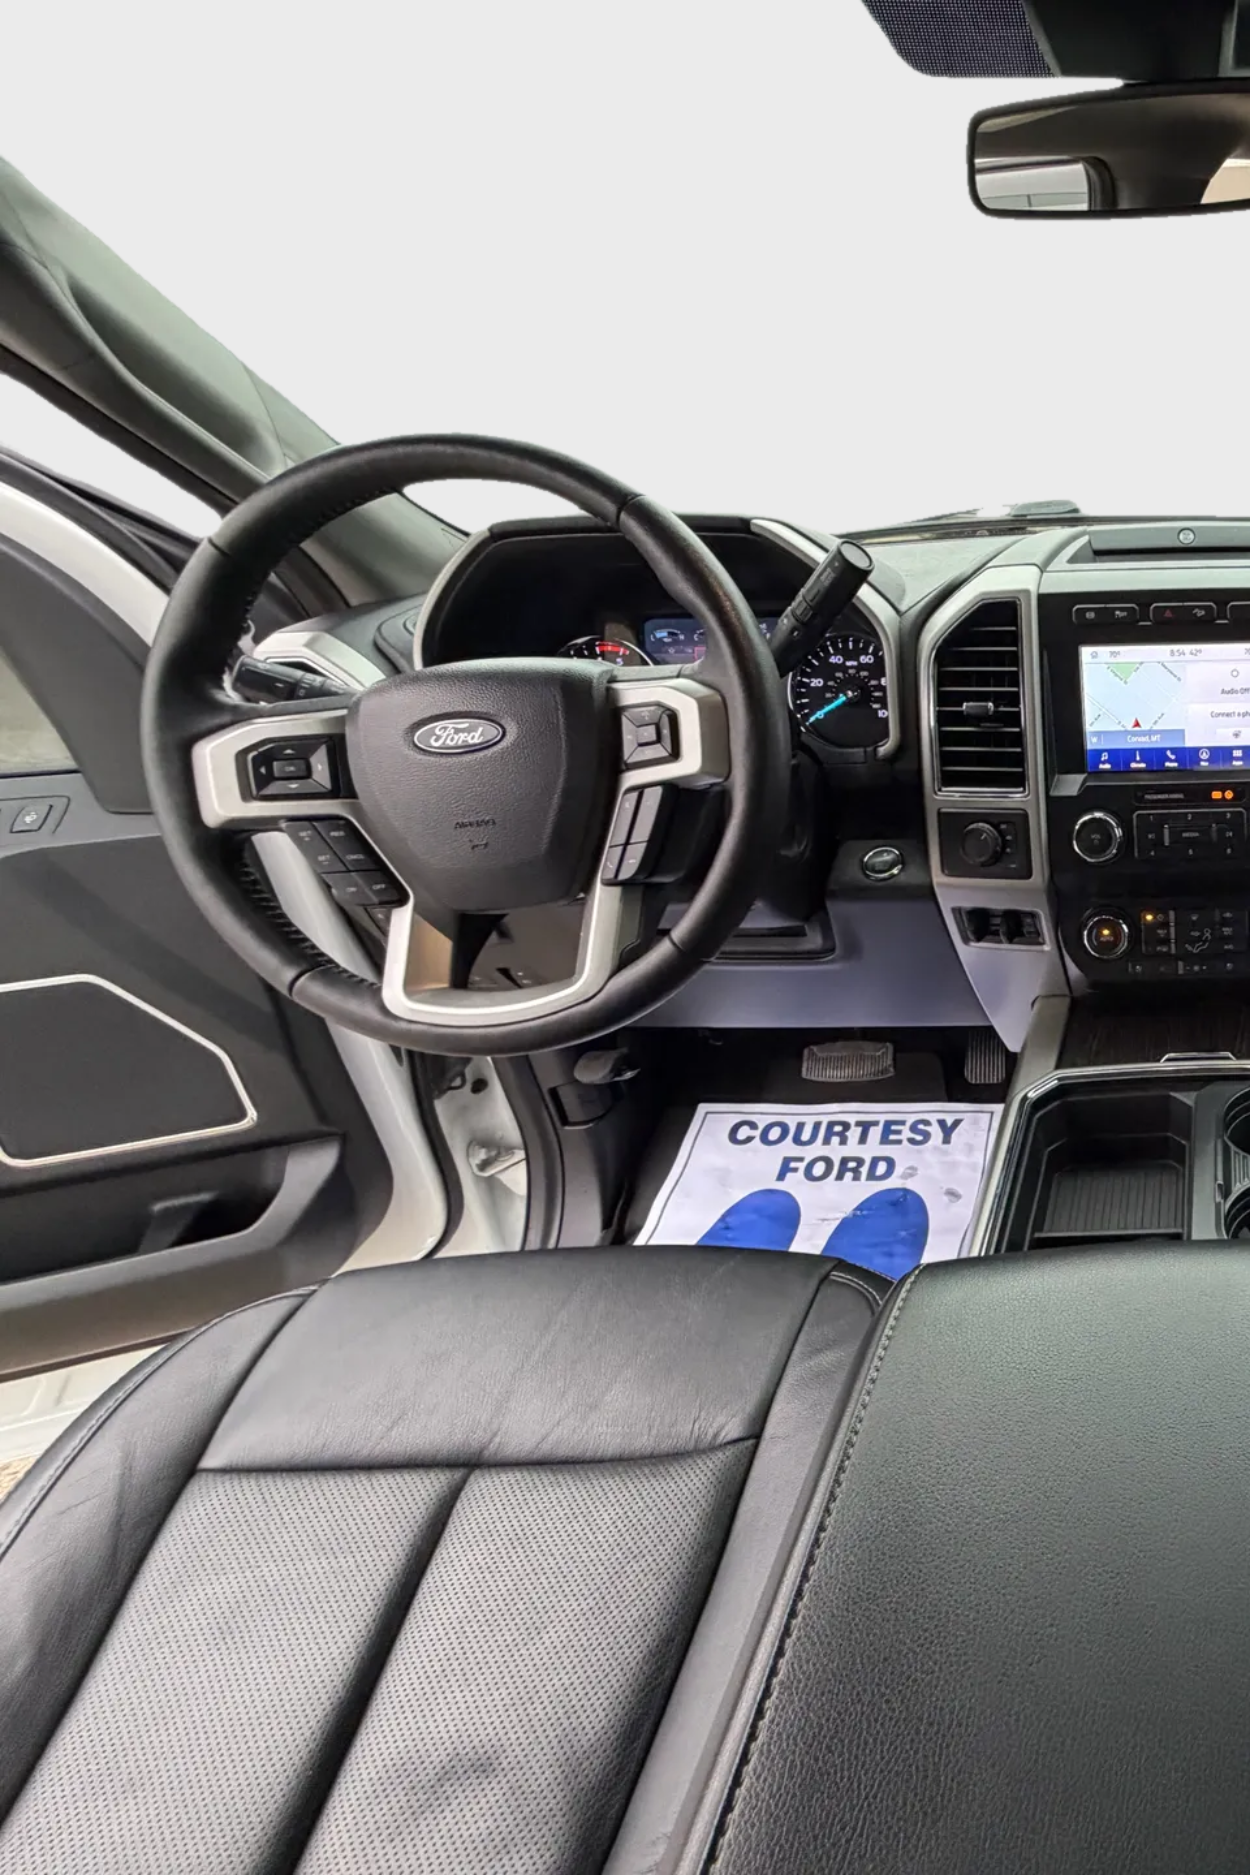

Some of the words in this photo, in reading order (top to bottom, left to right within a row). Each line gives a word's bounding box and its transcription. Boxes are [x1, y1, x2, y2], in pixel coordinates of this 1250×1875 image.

[1169, 649, 1186, 657] 8:54
[616, 657, 624, 666] 5
[829, 655, 844, 664] 40
[859, 655, 874, 664] 60
[810, 678, 824, 687] 20
[1239, 687, 1250, 695] Off
[1210, 710, 1236, 719] Connect
[430, 723, 484, 747] Ford
[1090, 735, 1099, 743] W
[1150, 733, 1161, 742] MT
[727, 1118, 965, 1147] COURTESY
[775, 1155, 896, 1183] FORD
